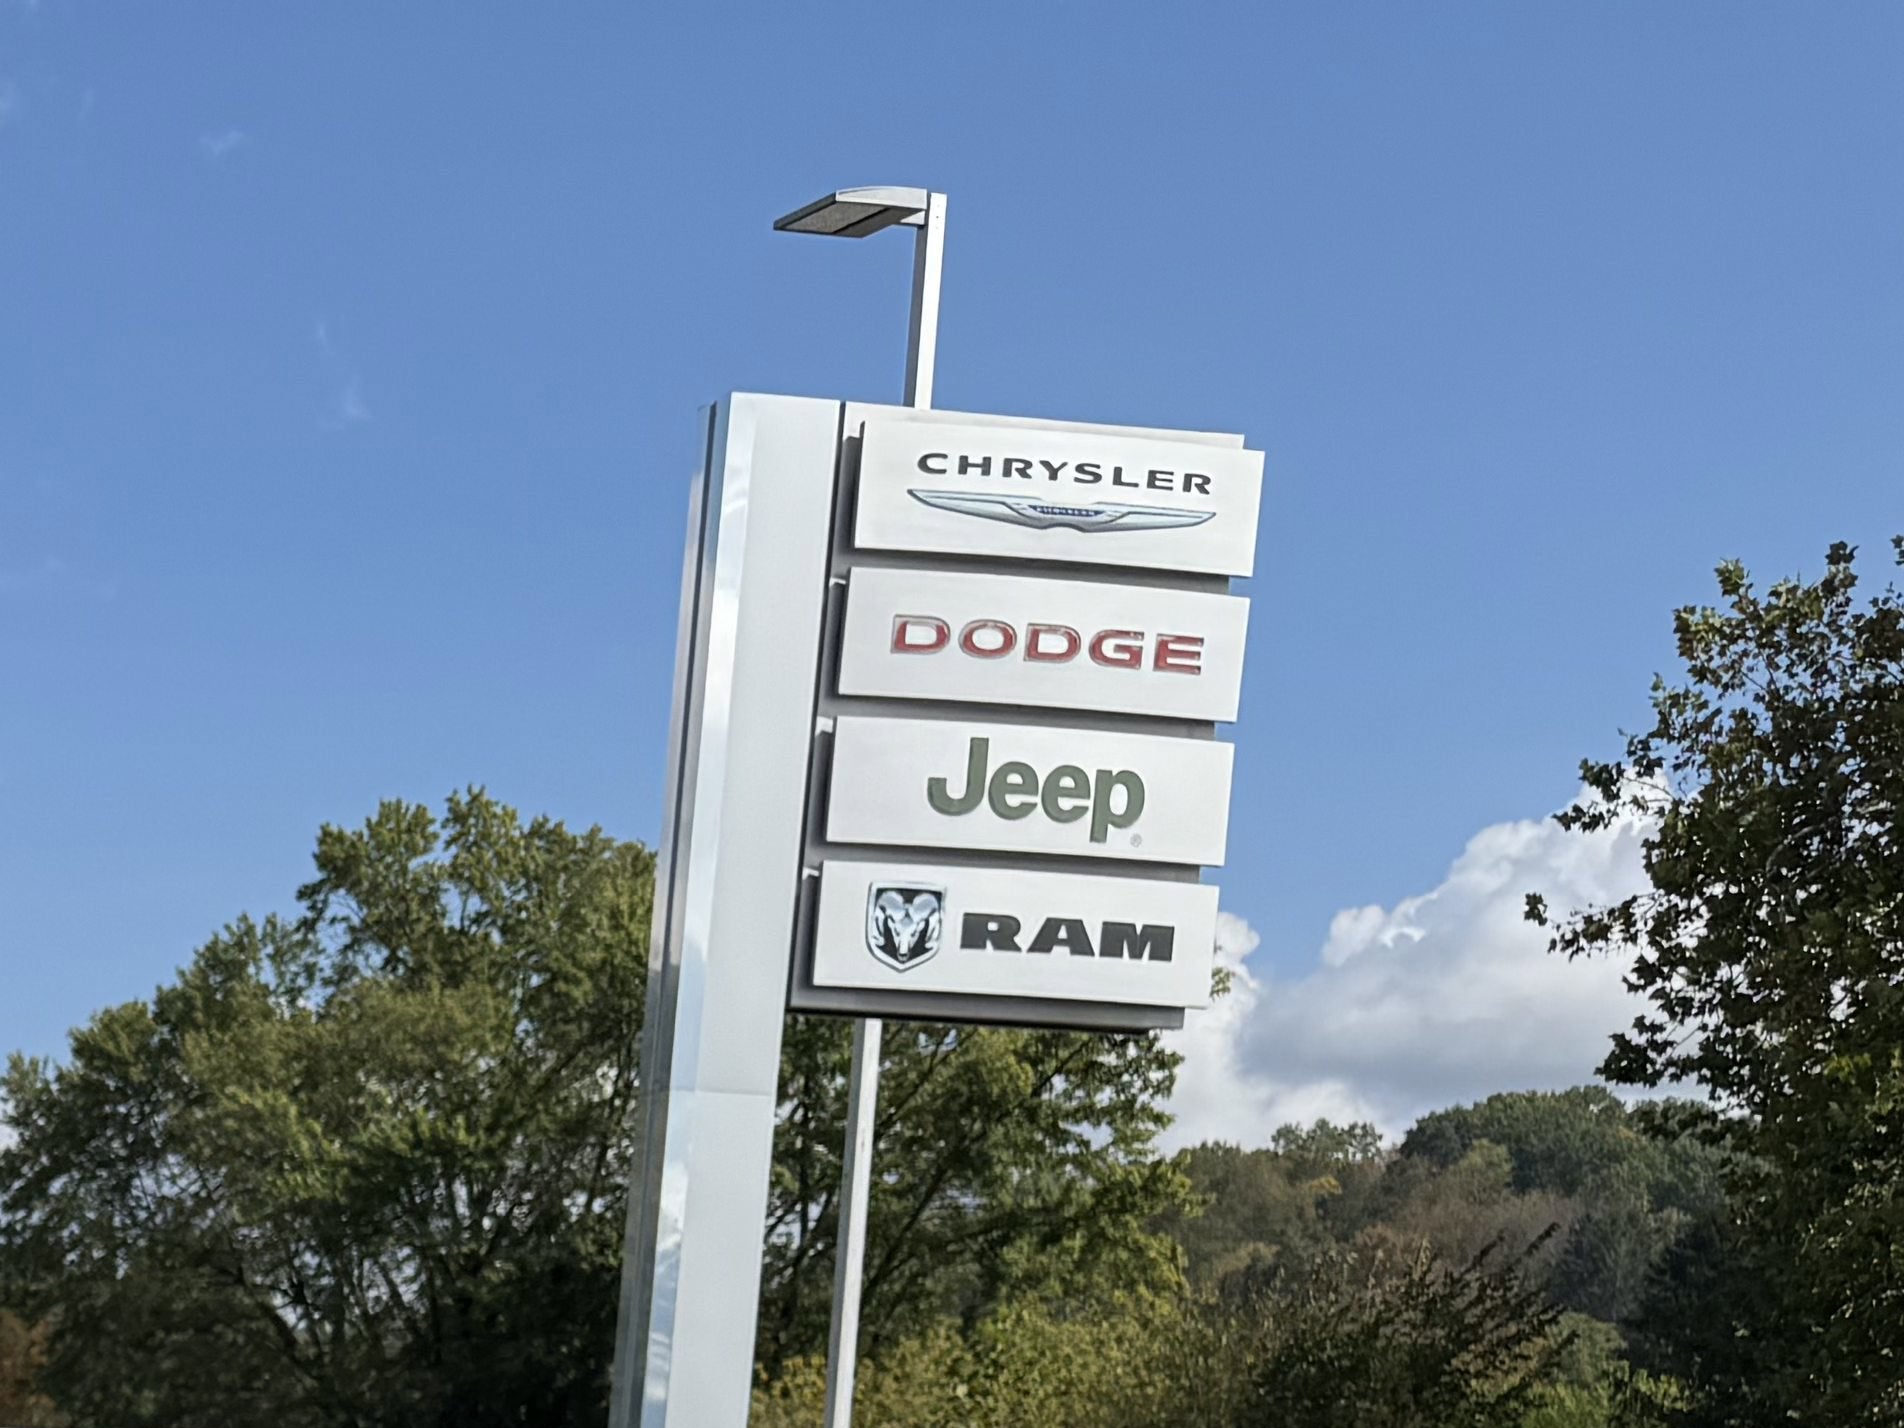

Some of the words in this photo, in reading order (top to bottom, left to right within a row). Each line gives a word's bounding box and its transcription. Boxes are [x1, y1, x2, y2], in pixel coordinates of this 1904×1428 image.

[916, 452, 1213, 496] CHRYSLER
[890, 613, 1205, 676] DODGE
[927, 737, 1146, 843] Jeep
[959, 912, 1176, 963] RAM
